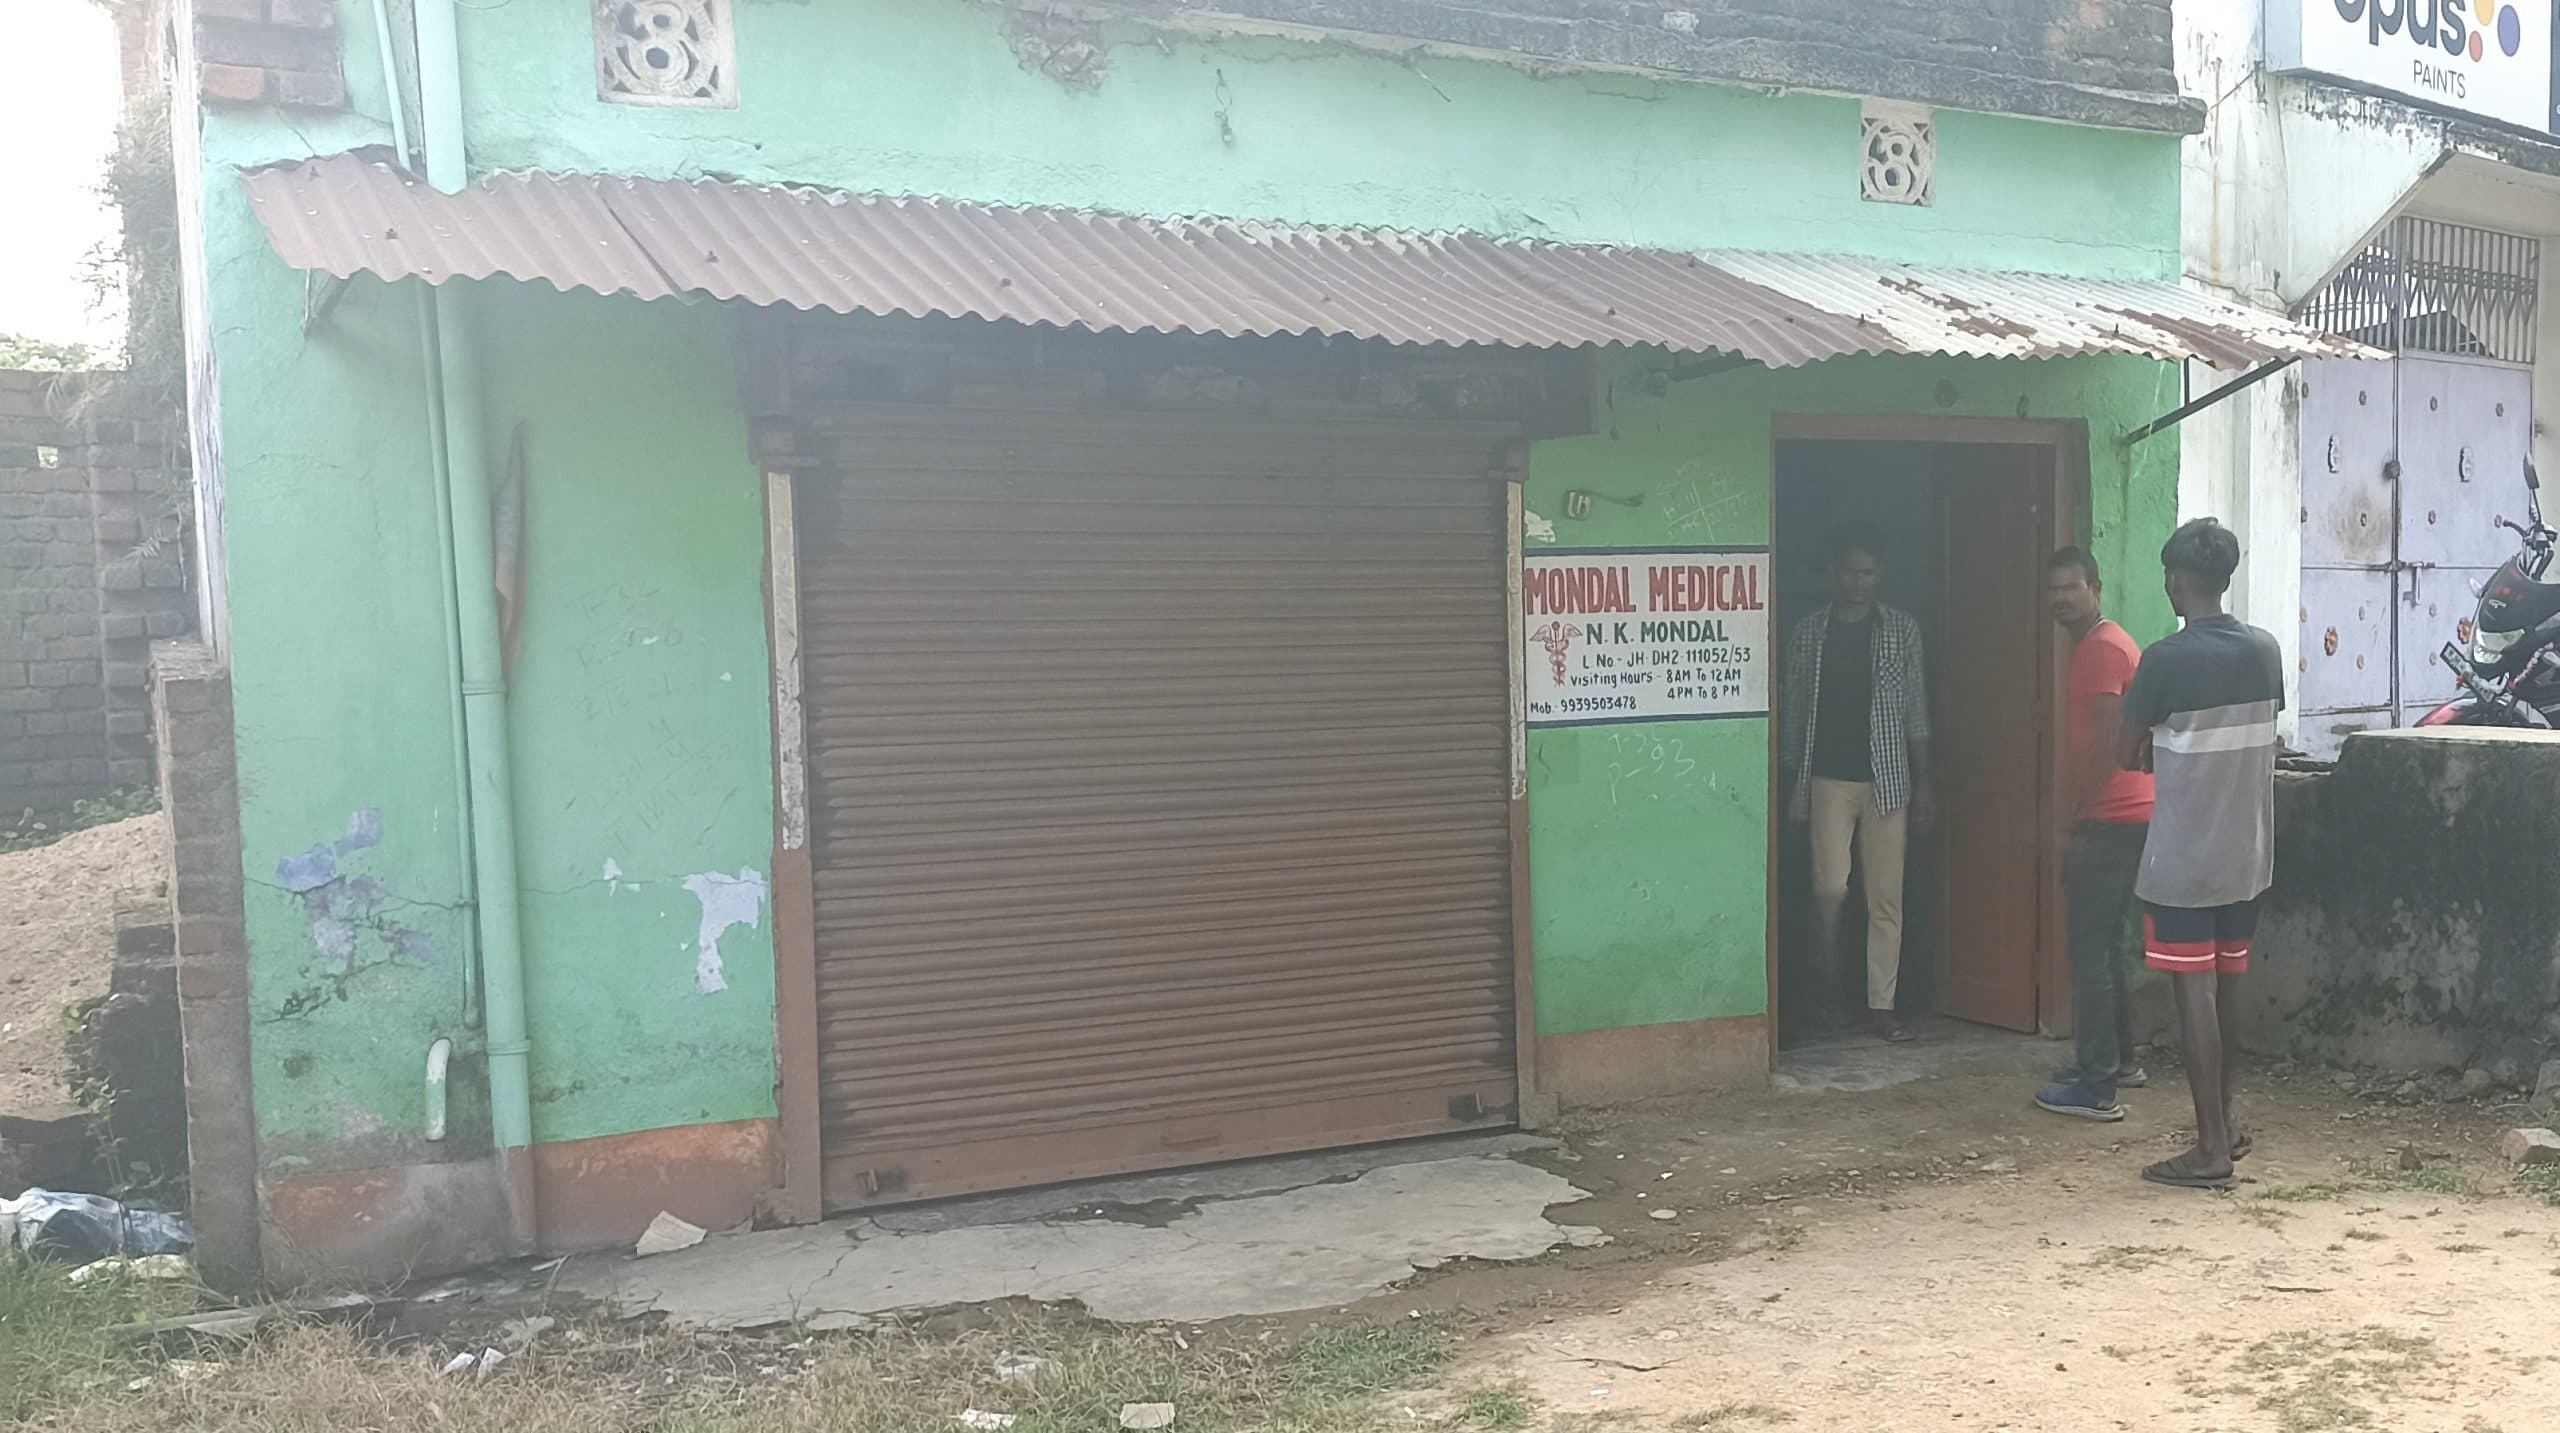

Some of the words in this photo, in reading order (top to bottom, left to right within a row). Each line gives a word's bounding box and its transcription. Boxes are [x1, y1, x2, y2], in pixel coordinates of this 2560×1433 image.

[2413, 59, 2466, 99] PAINTS
[1525, 565, 1637, 615] MONDAL
[1649, 564, 1764, 612] MEDICAL
[1586, 622, 1608, 645] N.
[1614, 621, 1635, 644] K.
[1640, 619, 1729, 643] MONDAL
[1620, 671, 1653, 684] Hours
